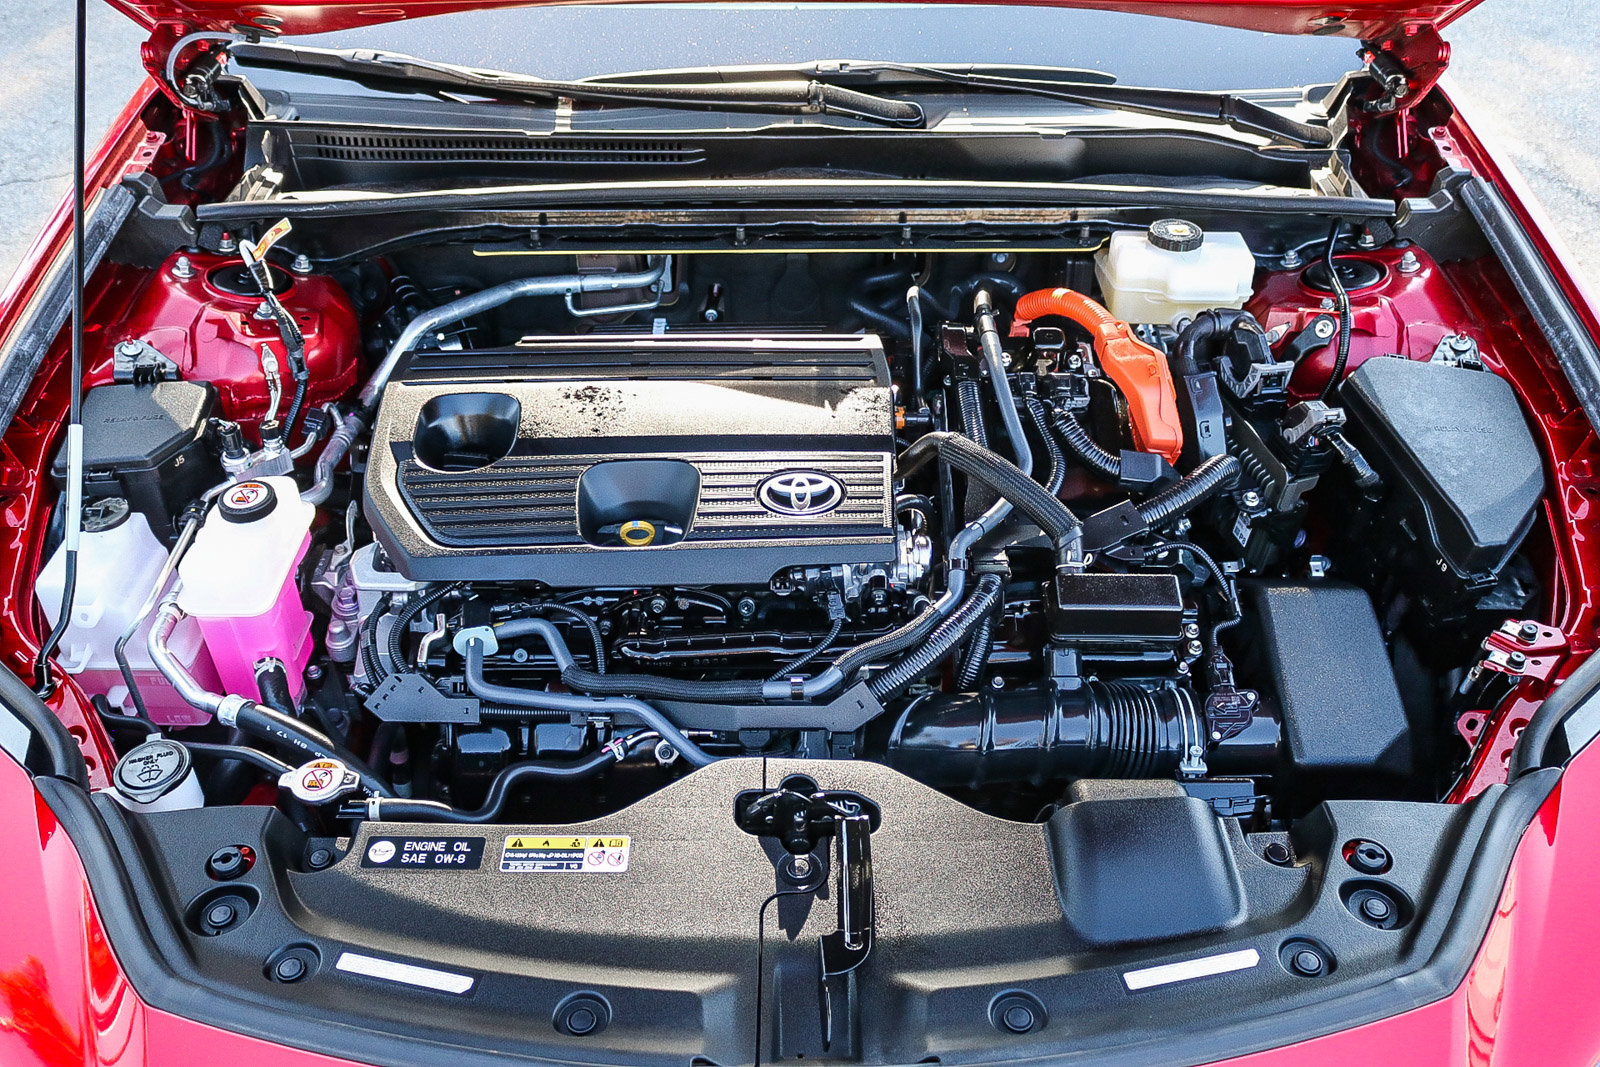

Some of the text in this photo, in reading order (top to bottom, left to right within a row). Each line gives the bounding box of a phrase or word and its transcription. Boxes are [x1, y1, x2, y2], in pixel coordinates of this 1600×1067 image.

[174, 455, 185, 467] J5
[1435, 558, 1447, 572] J9
[403, 841, 472, 852] ENGINE OIL
[400, 853, 467, 864] SAE 0W-8
